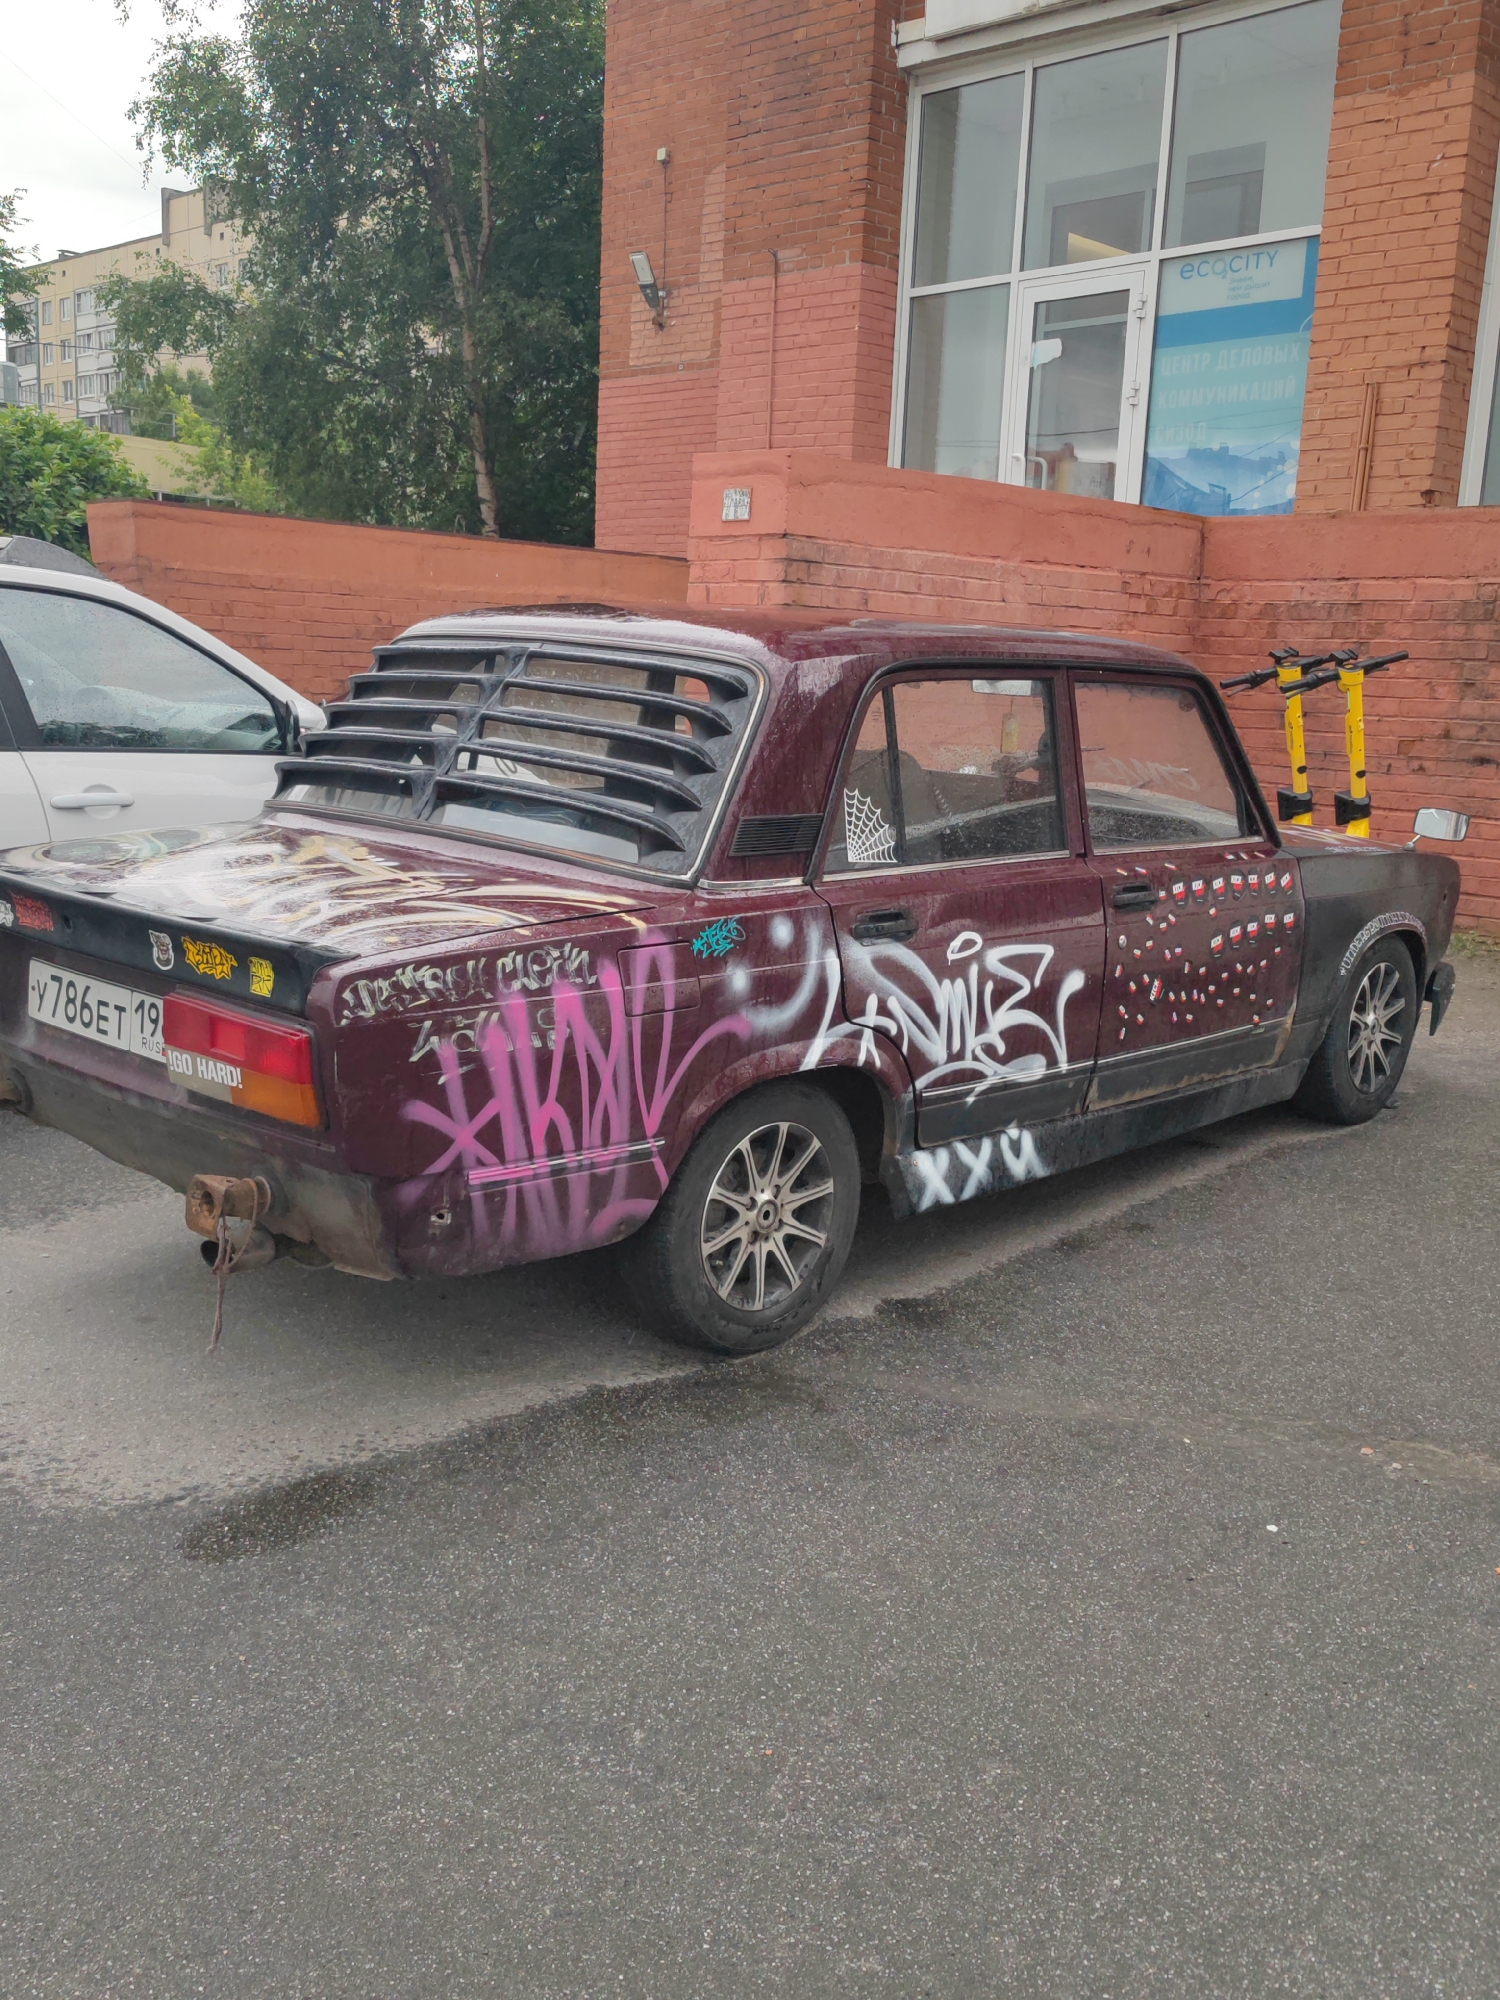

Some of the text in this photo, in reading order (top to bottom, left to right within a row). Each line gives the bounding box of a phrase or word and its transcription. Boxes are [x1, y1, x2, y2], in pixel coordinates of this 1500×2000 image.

[1161, 342, 1301, 376] ЦЕНТР ДЕЛОВЫХ
[1157, 375, 1297, 409] КОММУНИКАЦИЙ
[1149, 978, 1160, 1001] KICK
[134, 999, 165, 1040] 19
[142, 1036, 161, 1054] RUS
[167, 1049, 243, 1089] !GO HARD!
